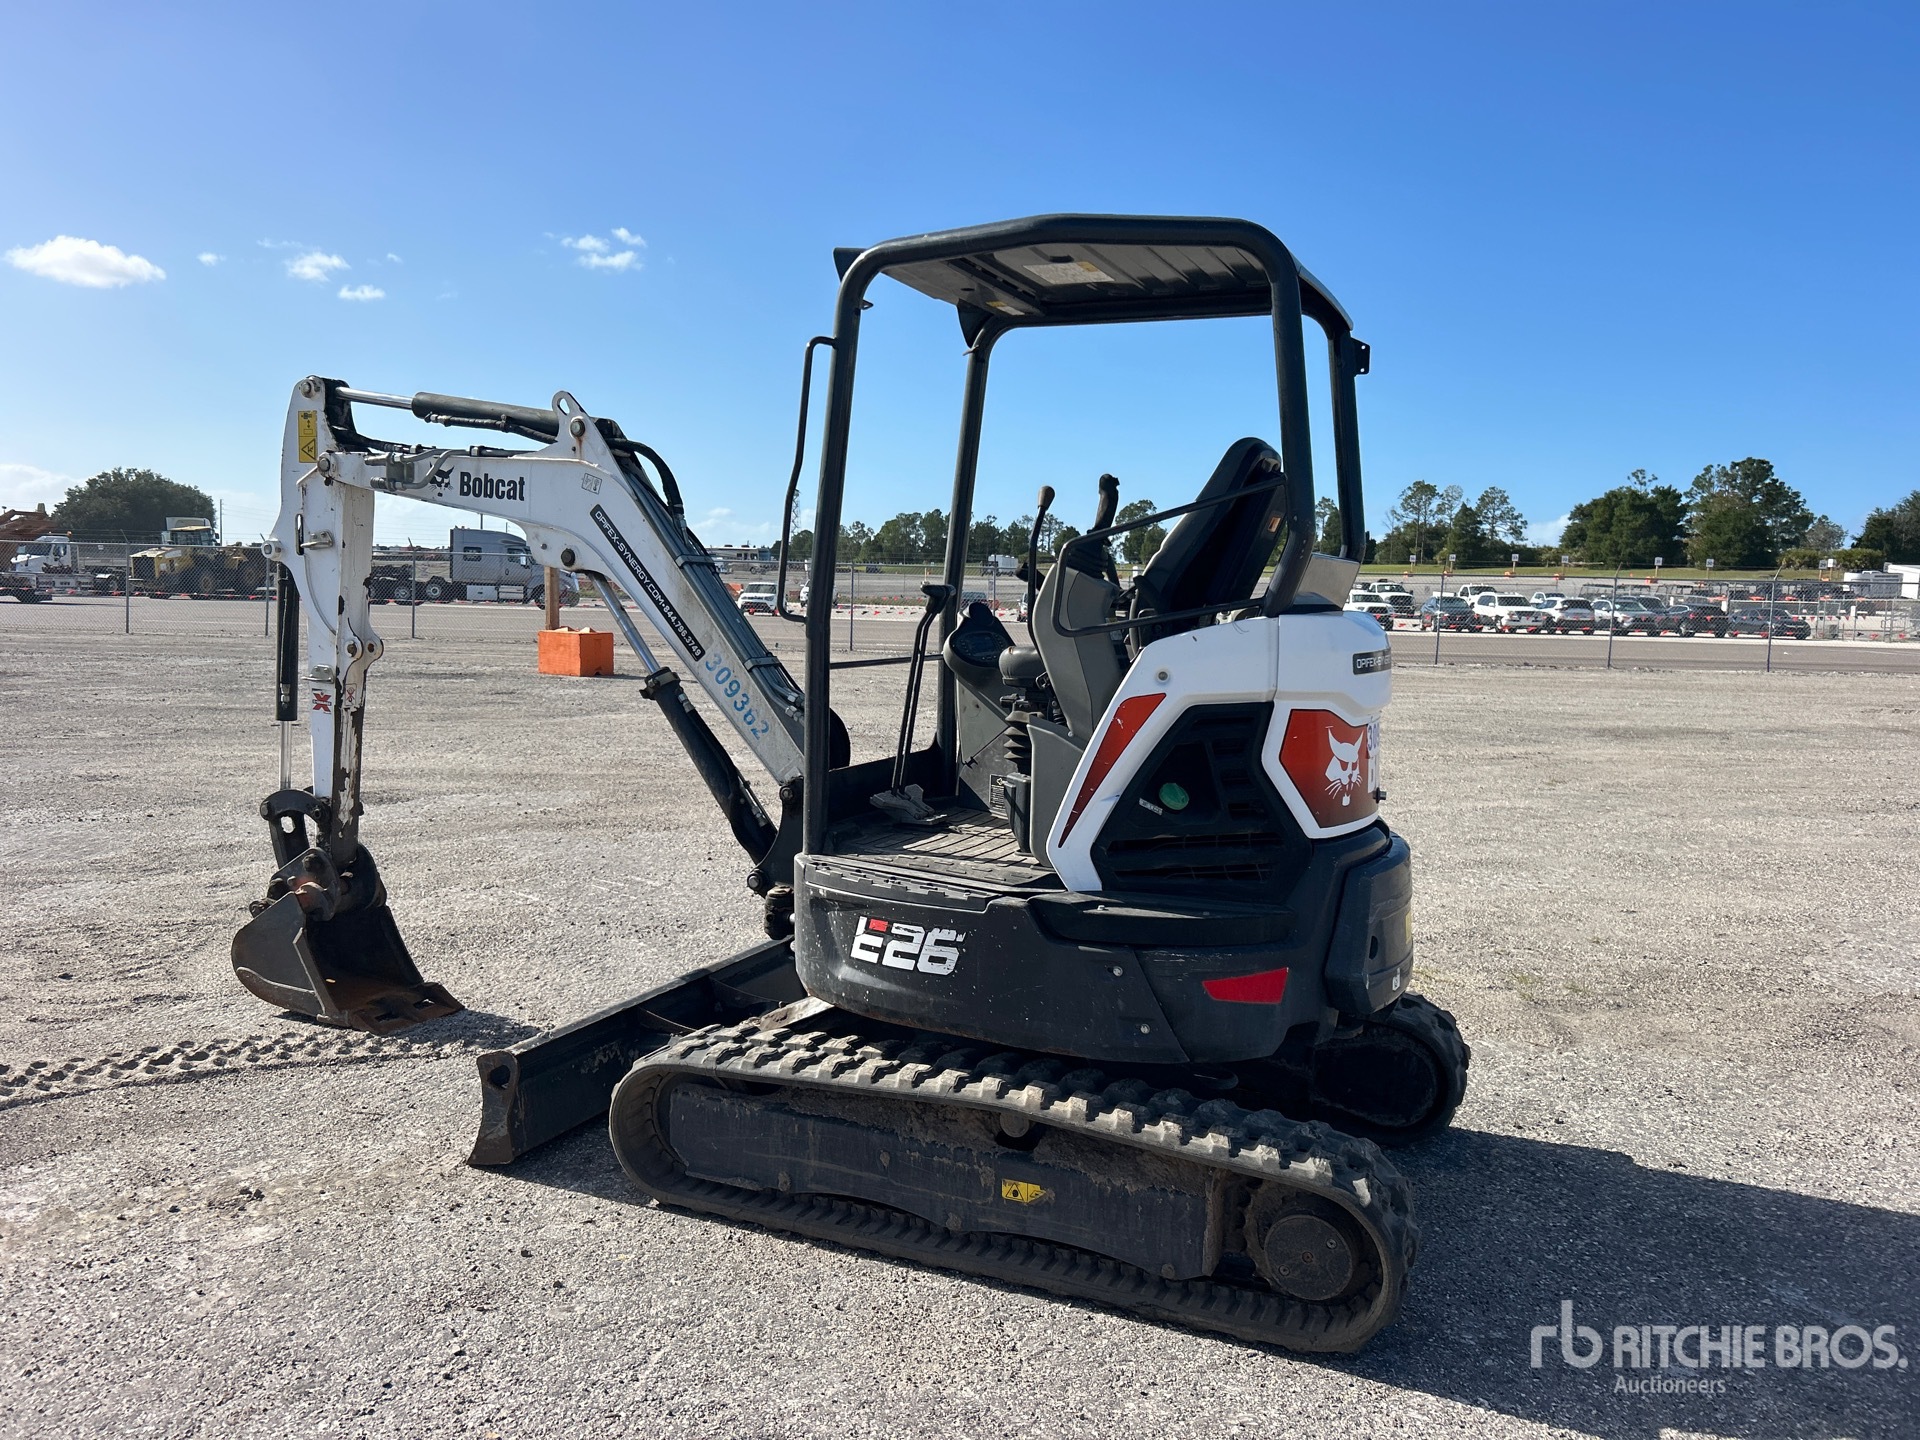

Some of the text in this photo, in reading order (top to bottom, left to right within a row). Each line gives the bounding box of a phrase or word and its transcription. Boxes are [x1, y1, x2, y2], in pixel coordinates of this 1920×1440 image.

[459, 471, 525, 501] Bobcat
[705, 652, 770, 741] 309362
[850, 915, 967, 976] E26
